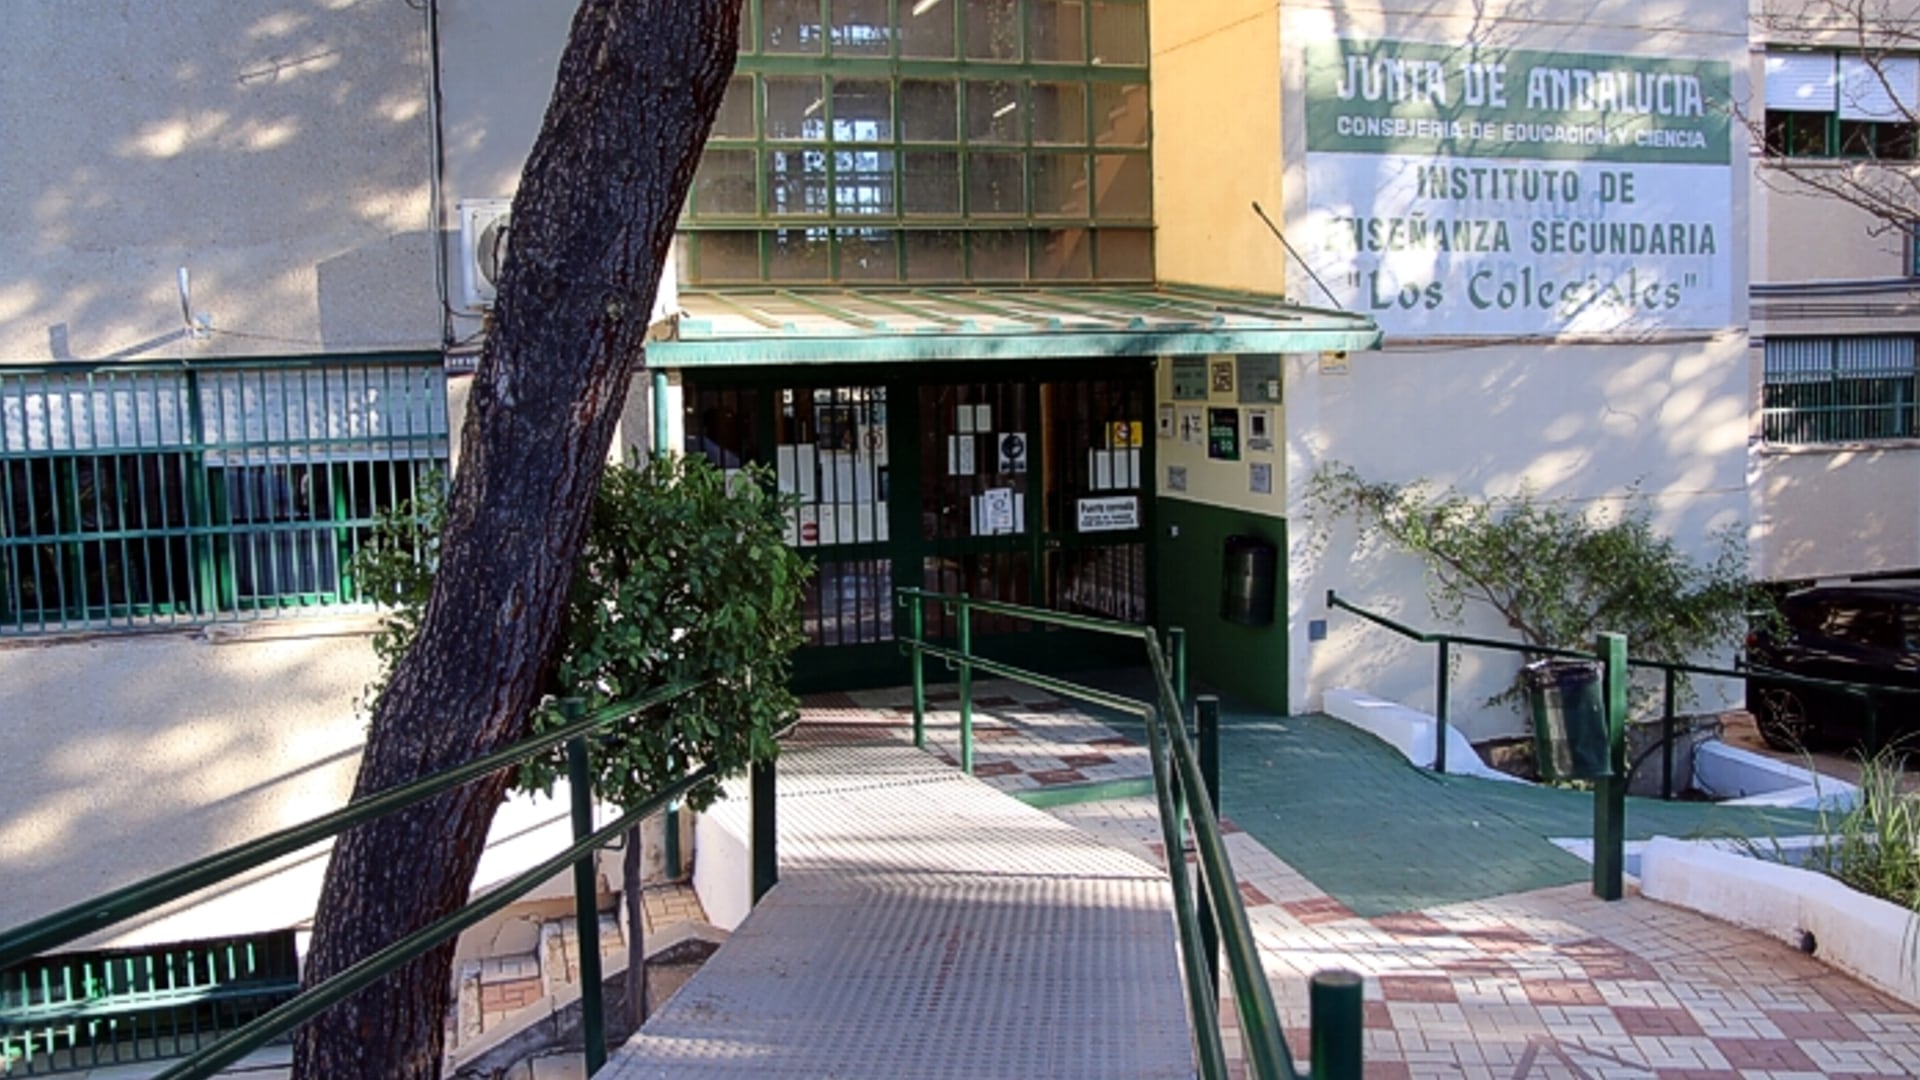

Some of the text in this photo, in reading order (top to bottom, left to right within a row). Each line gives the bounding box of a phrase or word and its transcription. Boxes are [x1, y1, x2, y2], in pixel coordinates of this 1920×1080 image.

[1337, 55, 1705, 117] JUNTA DE ANDALUCIA
[1337, 115, 1463, 140] CONSEJERIA
[1469, 121, 1496, 140] DE
[1614, 127, 1630, 146] Y
[1634, 129, 1707, 149] CIENCIA
[1416, 165, 1636, 204] INSTITUTO DE
[1530, 220, 1716, 255] SECUNDARIA
[1348, 269, 1444, 310] "Los
